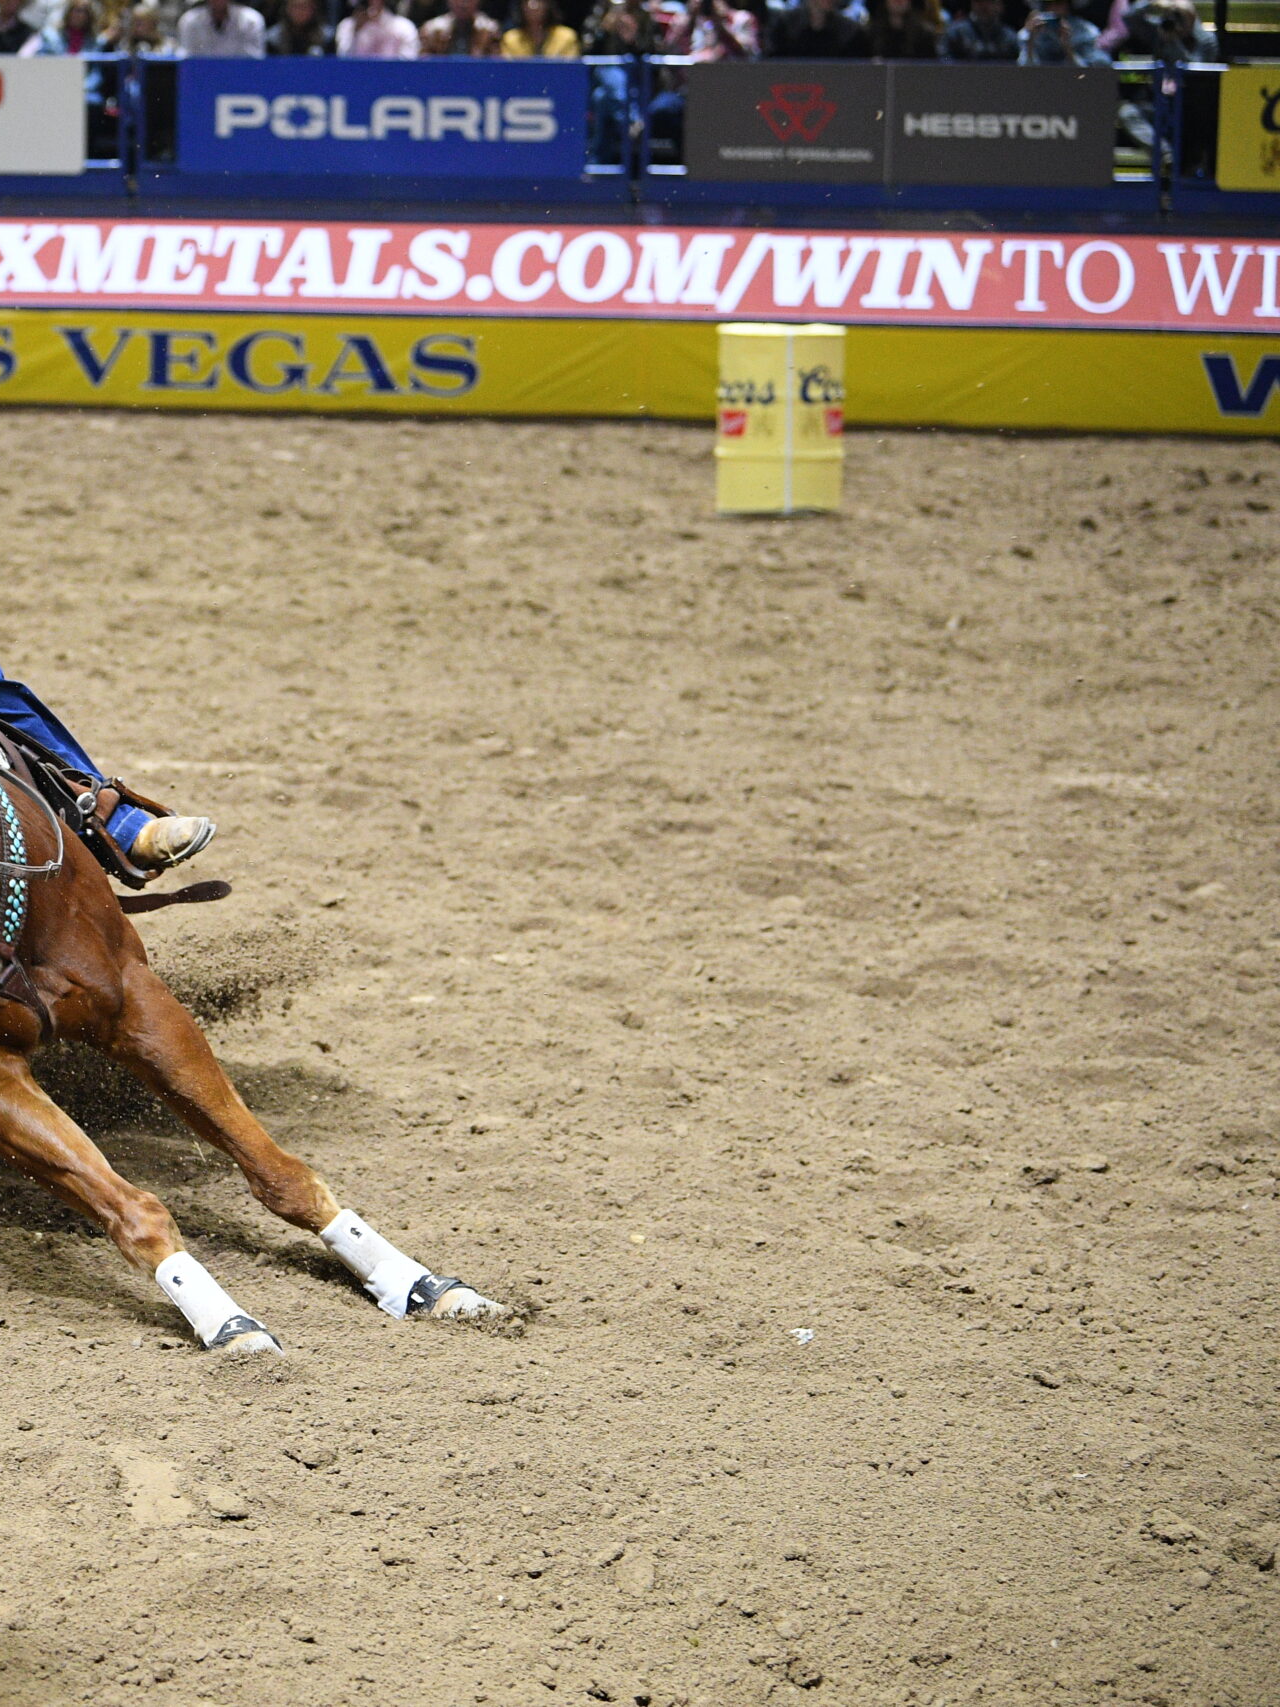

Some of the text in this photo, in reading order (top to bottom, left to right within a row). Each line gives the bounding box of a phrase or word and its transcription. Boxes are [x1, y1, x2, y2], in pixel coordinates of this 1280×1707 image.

[215, 94, 557, 141] POLARIS
[903, 113, 1078, 139] HESSTON
[1001, 240, 1135, 314] TO
[54, 326, 482, 397] VEGAS
